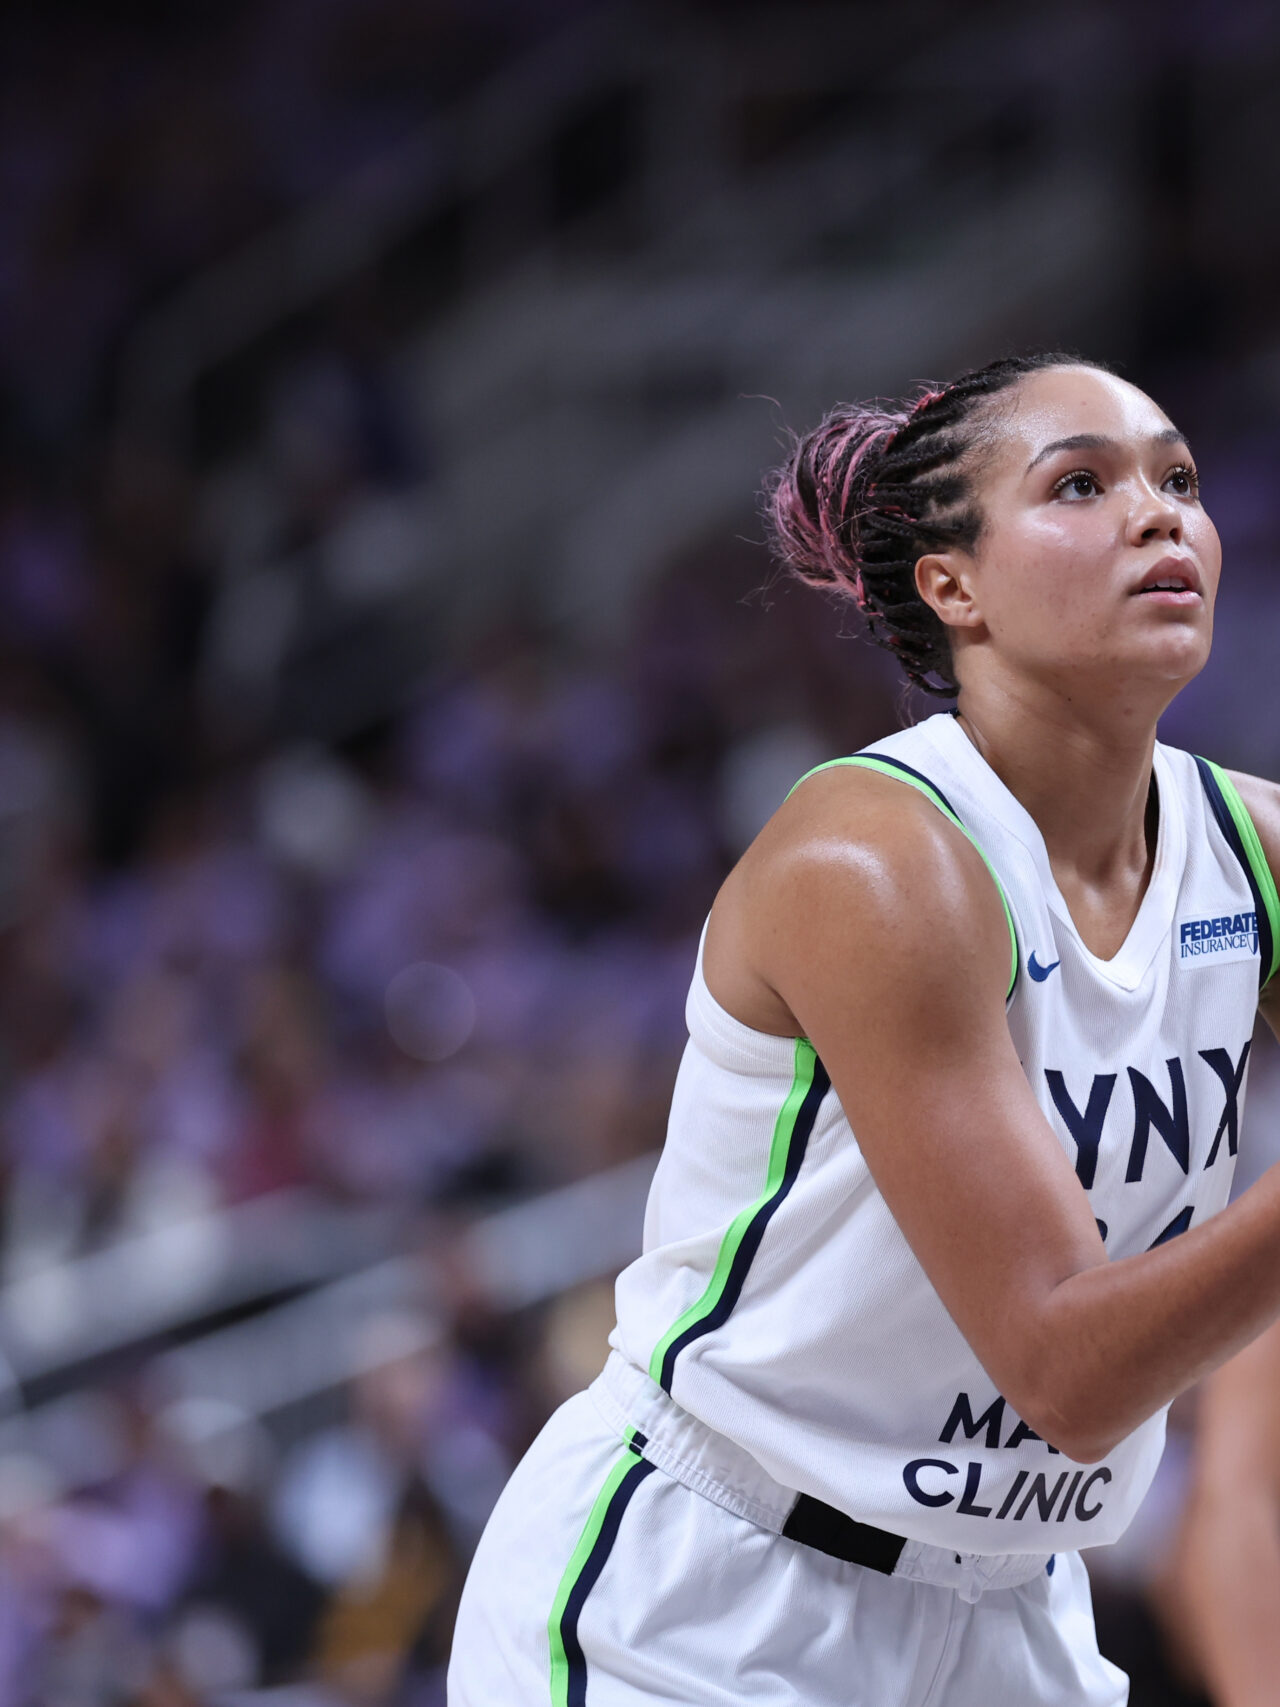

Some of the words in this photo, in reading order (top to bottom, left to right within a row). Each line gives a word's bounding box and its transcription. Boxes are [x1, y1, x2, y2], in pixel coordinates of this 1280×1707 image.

[1180, 911, 1258, 944] FEDERATE
[1181, 934, 1247, 958] INSURANCE
[1044, 1039, 1252, 1190] YNX
[938, 1392, 1060, 1454] MA
[903, 1458, 1112, 1522] CLINIC
